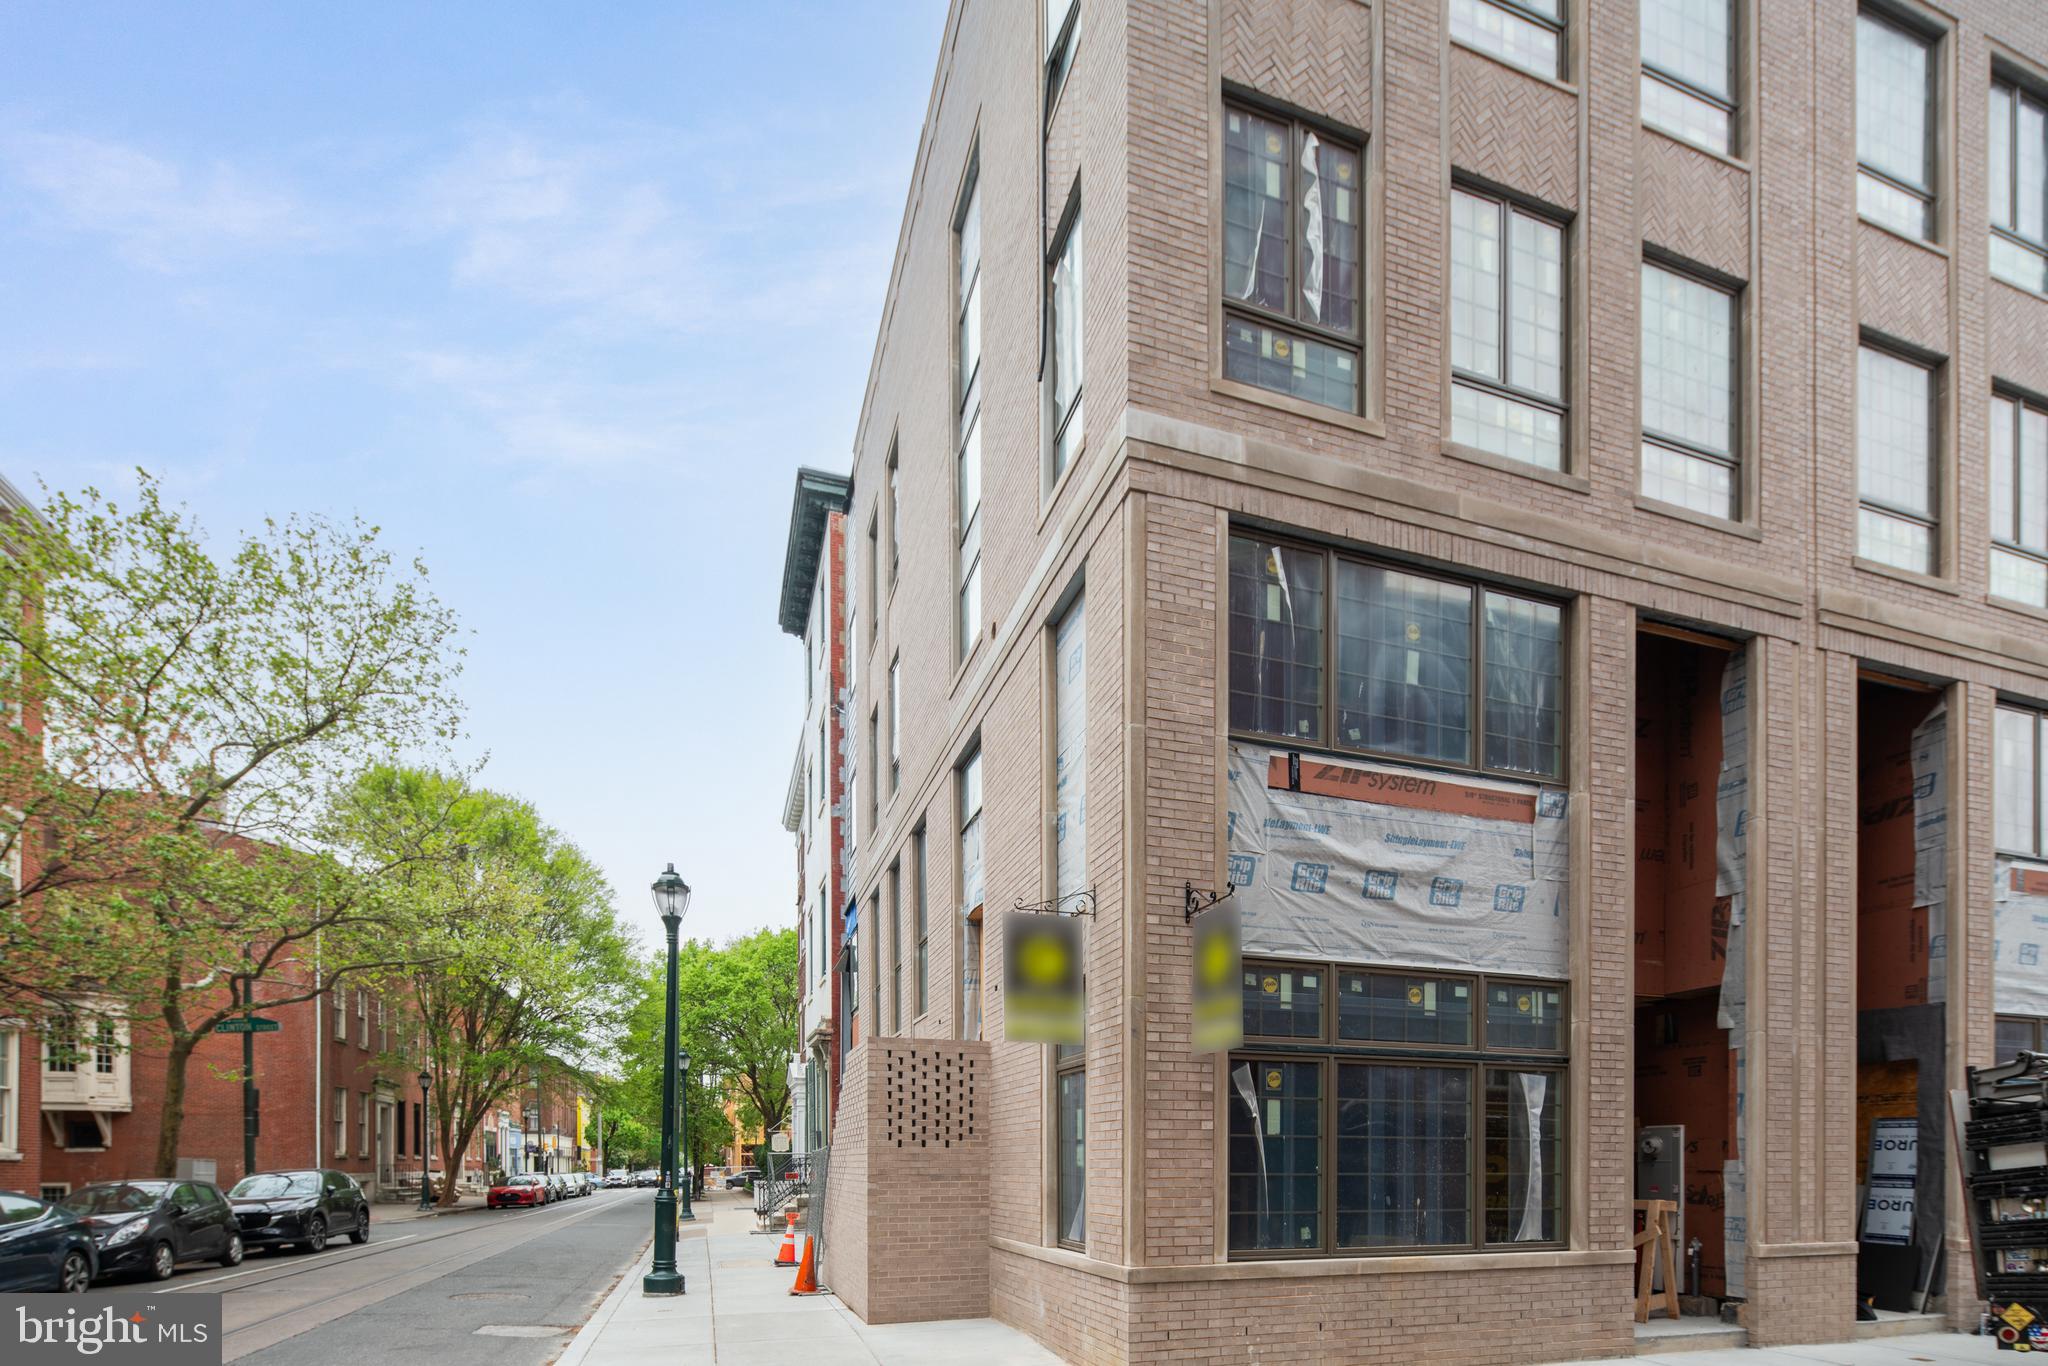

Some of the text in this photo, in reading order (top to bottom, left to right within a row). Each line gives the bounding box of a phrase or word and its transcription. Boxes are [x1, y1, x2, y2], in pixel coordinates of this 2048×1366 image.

[1298, 864, 1324, 879] Grip
[1295, 877, 1321, 892] Rite
[1368, 872, 1394, 887] Grip
[1367, 884, 1391, 898] Rite
[1435, 880, 1459, 894] Grip
[1501, 886, 1522, 900] Grip
[1433, 892, 1455, 905] Rite
[1497, 898, 1519, 911] Rite
[215, 1023, 252, 1032] CLINTON
